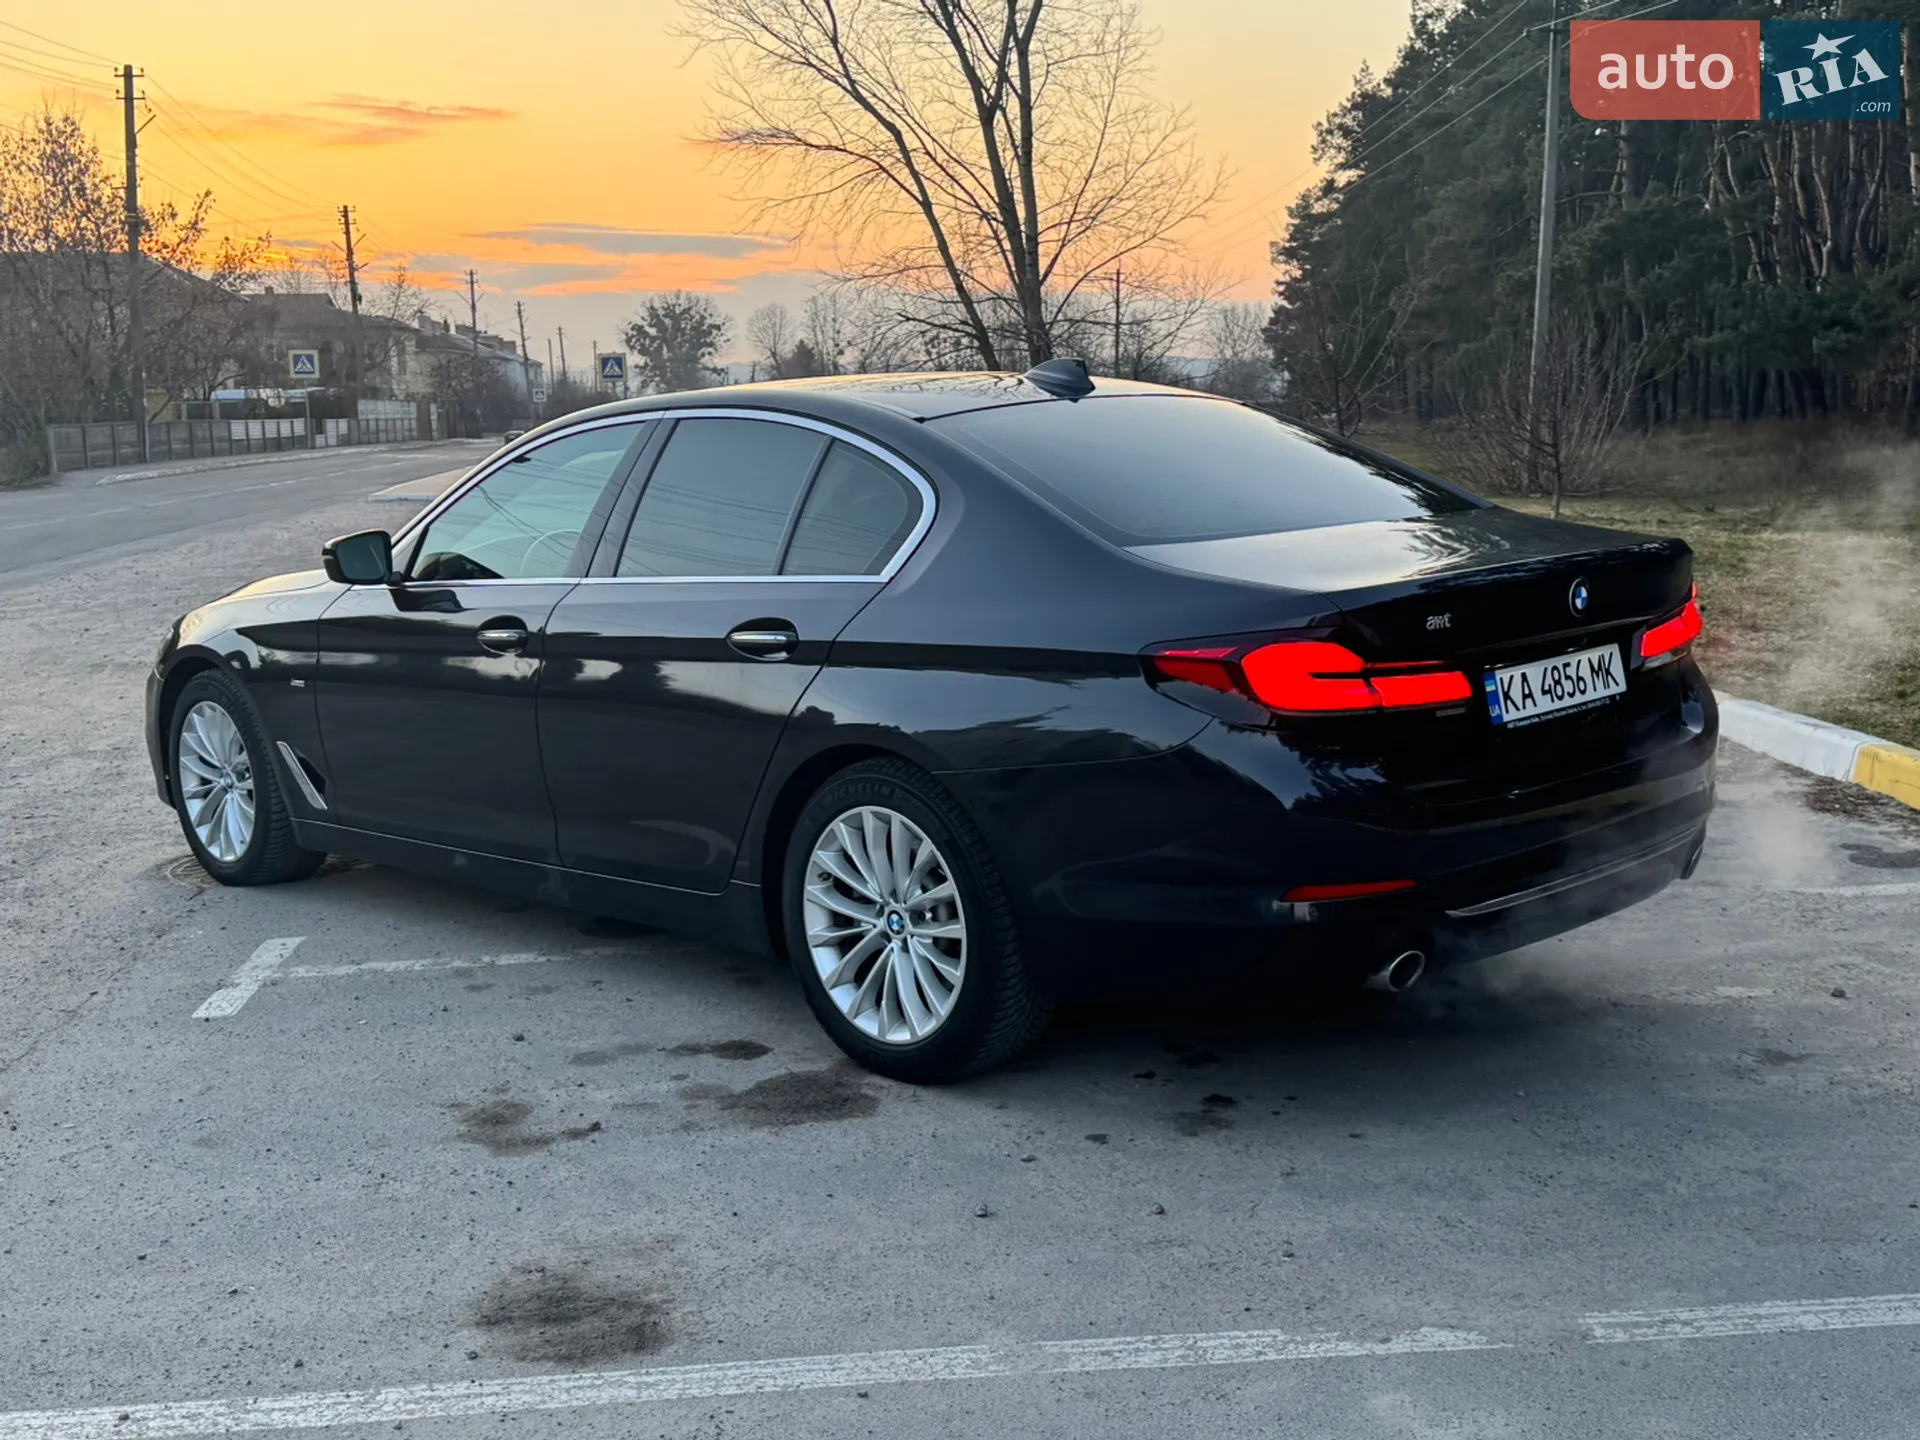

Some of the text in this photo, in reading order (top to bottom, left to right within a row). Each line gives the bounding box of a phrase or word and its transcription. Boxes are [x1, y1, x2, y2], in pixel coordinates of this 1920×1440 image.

[1499, 672, 1537, 714] KA
[1540, 659, 1587, 703] 4856
[1588, 651, 1620, 692] MK
[1489, 704, 1501, 716] UA
